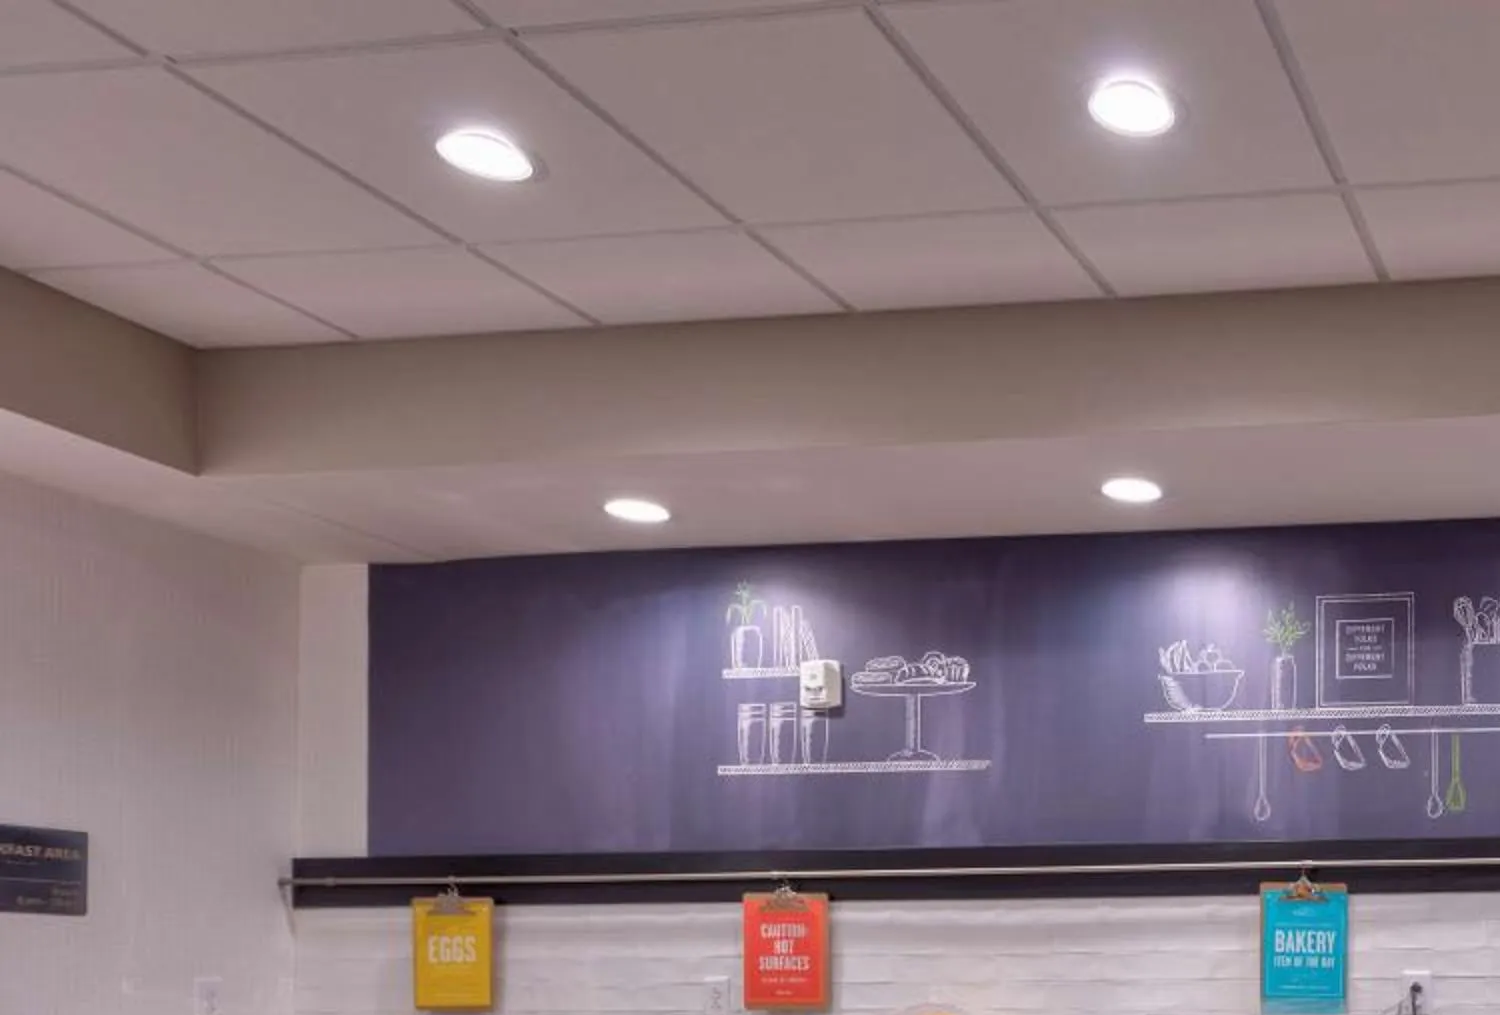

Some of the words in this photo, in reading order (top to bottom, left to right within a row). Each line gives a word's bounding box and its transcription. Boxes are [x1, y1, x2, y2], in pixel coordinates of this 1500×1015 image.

[428, 935, 477, 962] EGGS
[773, 940, 794, 954] HOT
[1275, 929, 1337, 953] BAKERY
[758, 955, 810, 971] SURFACES
